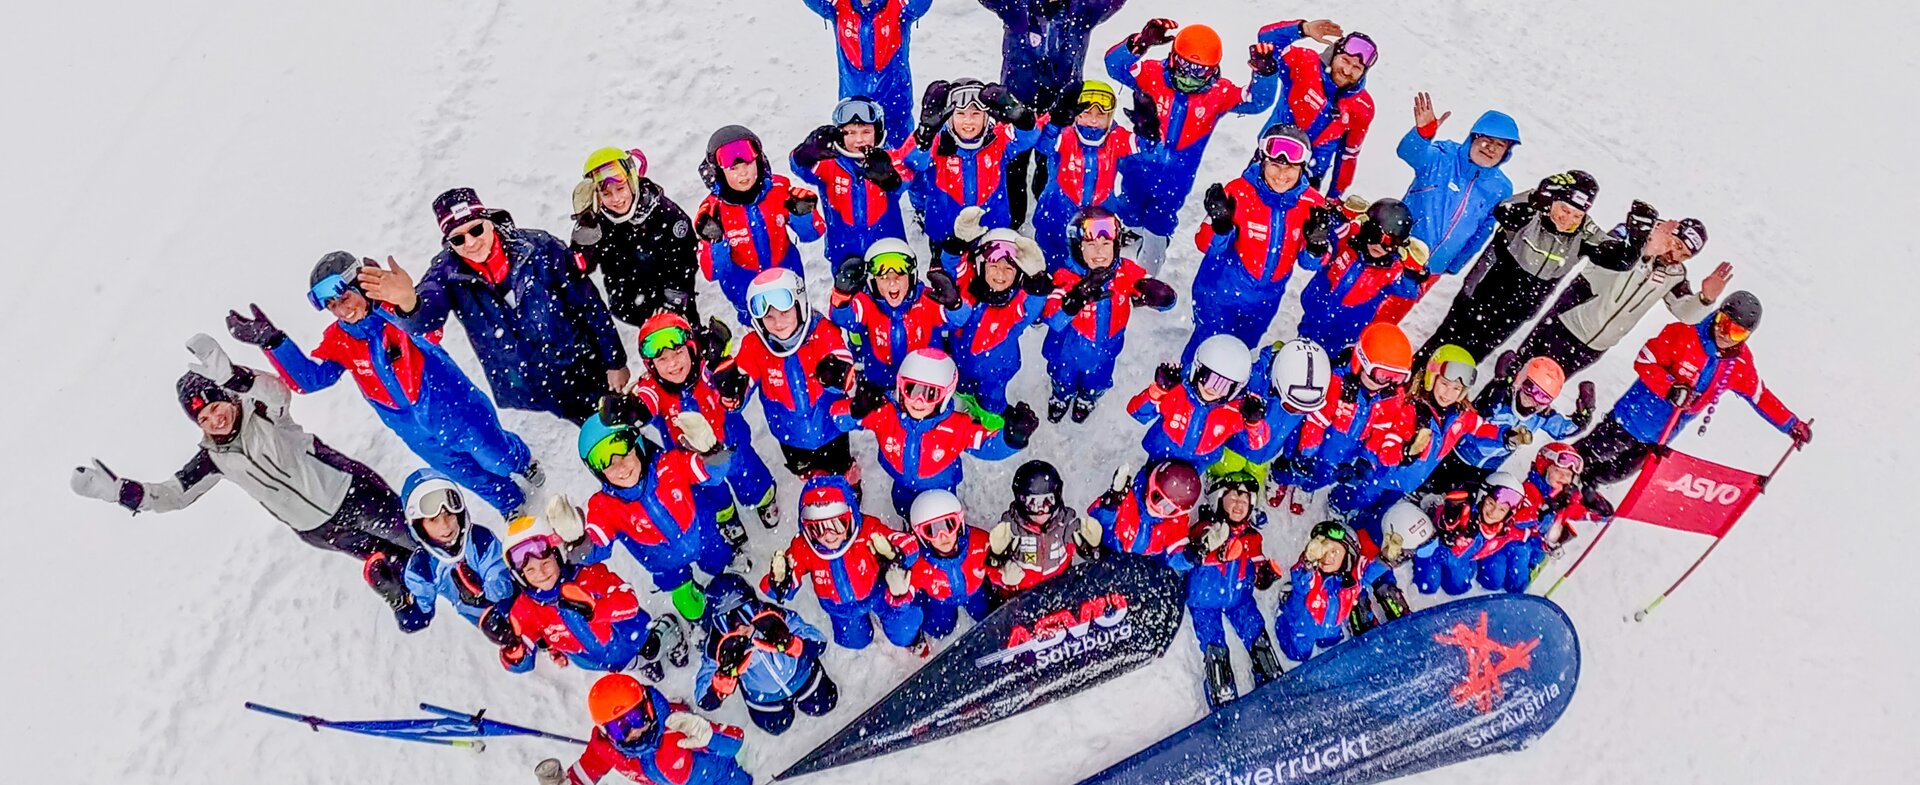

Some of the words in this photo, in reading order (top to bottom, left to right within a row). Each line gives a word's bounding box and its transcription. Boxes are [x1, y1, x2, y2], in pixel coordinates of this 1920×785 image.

[1665, 473, 1741, 505] ASVO
[1001, 594, 1128, 664] ASVO
[1035, 623, 1132, 669] Salzburg
[1466, 720, 1498, 749] Ski
[1502, 682, 1560, 732] Austria
